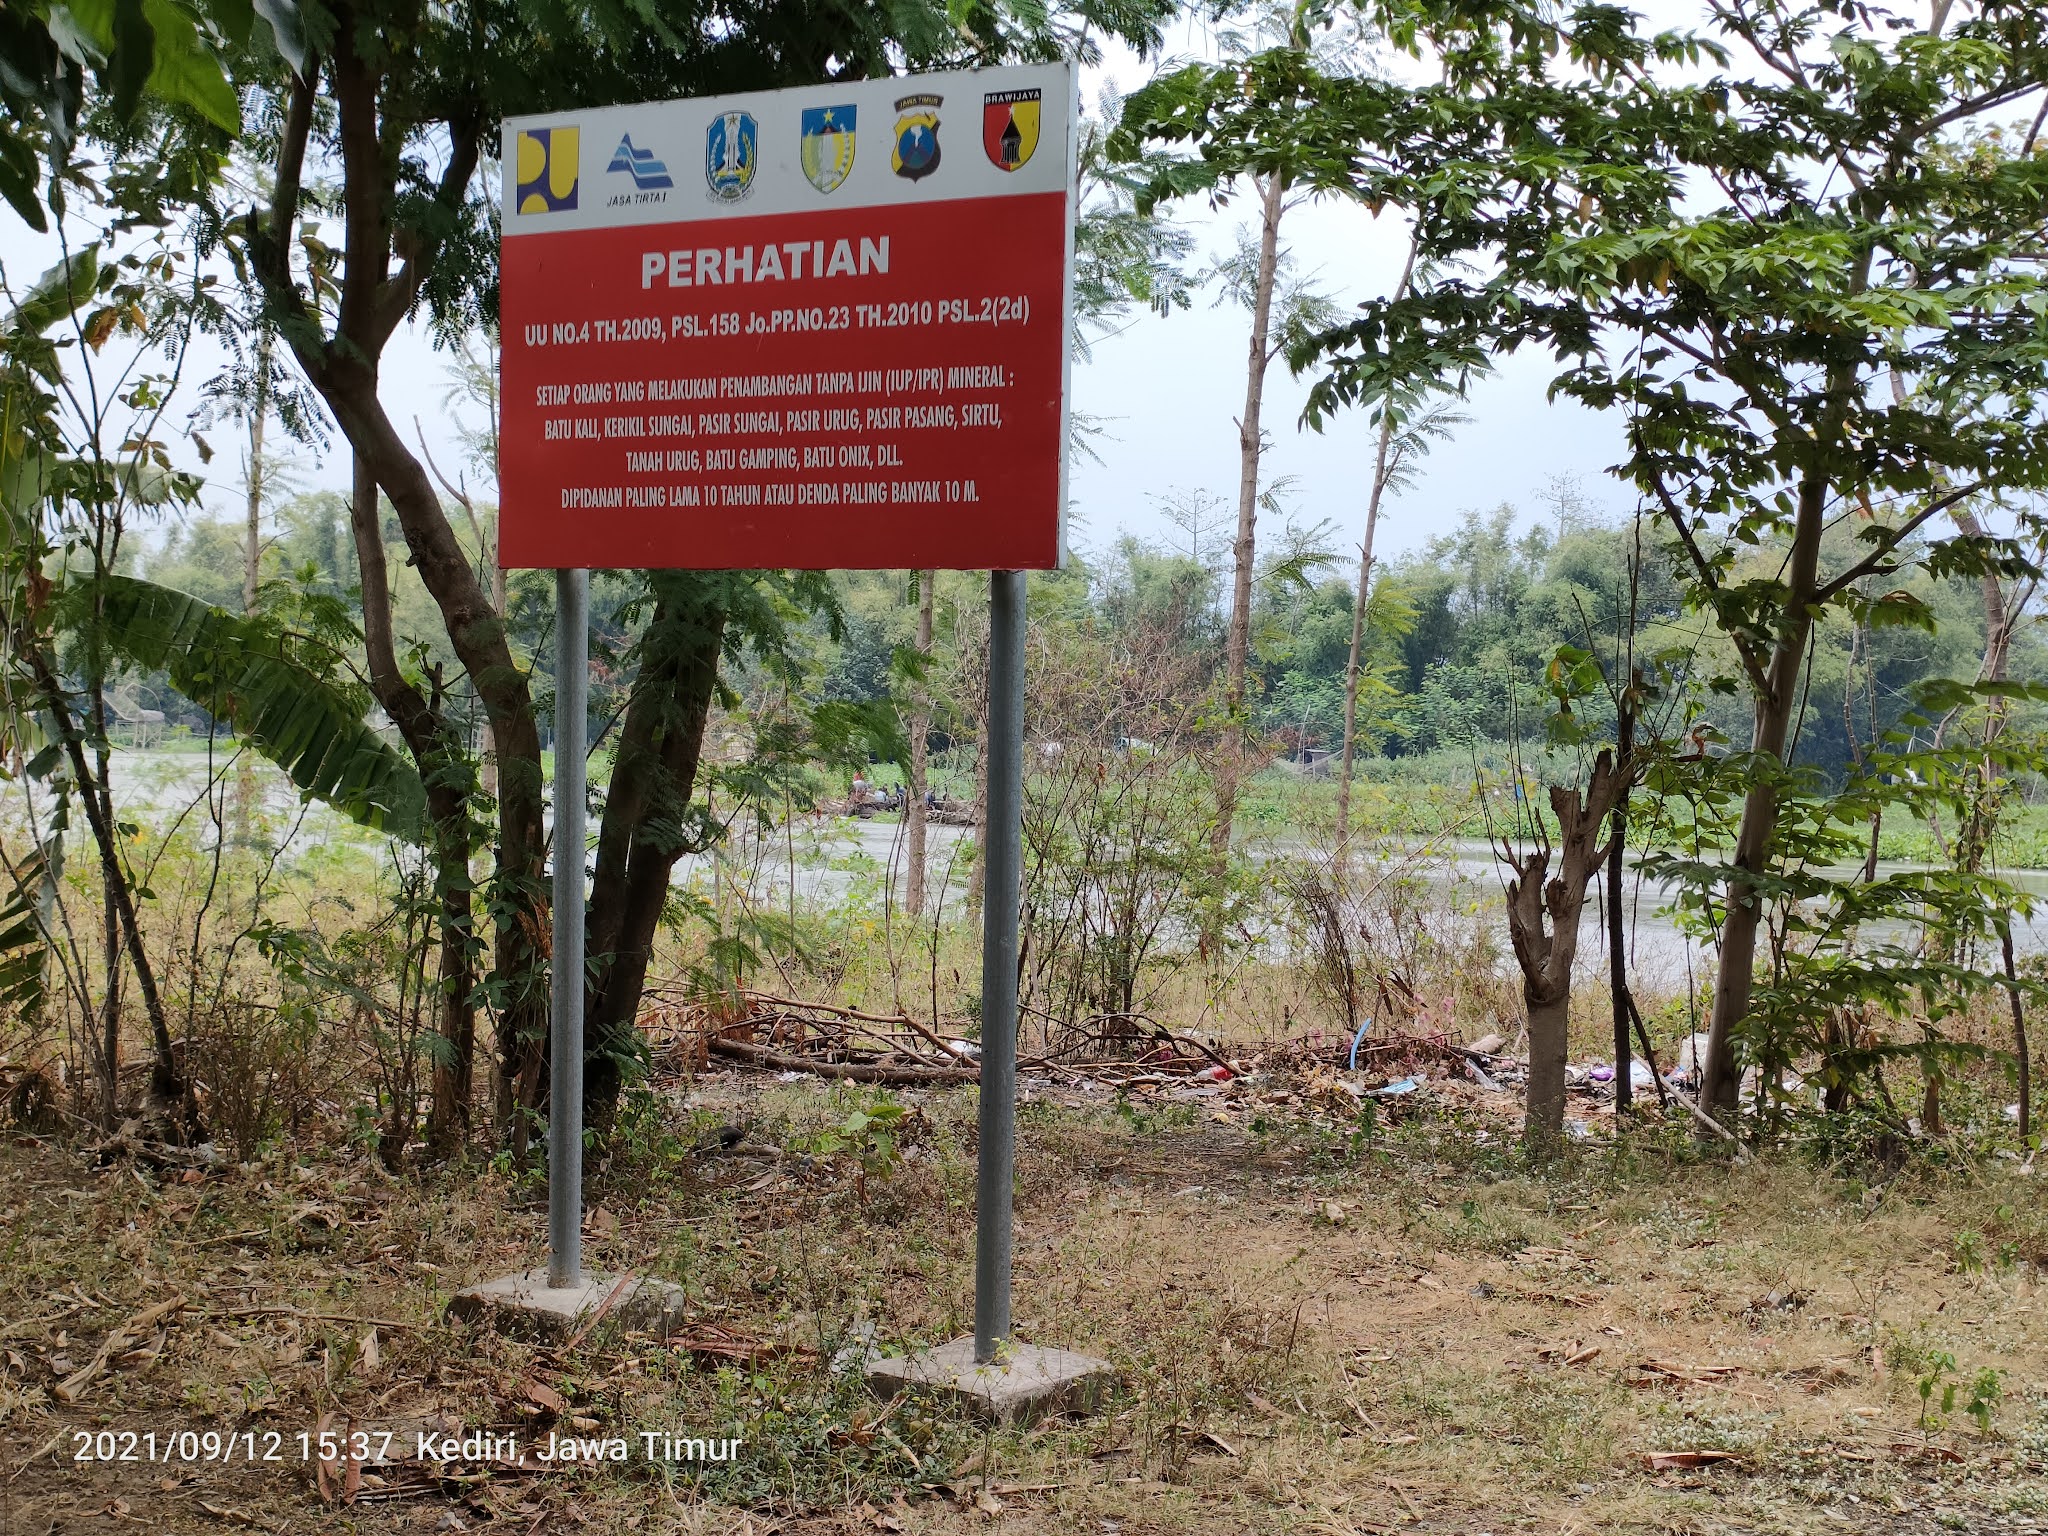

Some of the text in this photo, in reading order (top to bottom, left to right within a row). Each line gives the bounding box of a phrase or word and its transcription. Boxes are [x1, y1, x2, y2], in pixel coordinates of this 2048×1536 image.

[900, 95, 939, 109] JAWA TIMUR
[986, 90, 1040, 104] BRAWIJAYA
[606, 194, 632, 208] JASA
[635, 192, 661, 205] TIRTA
[642, 236, 889, 289] PERHATIAN
[525, 324, 548, 347] UU
[552, 321, 590, 345] NO.4
[593, 317, 667, 344] TH.2009,
[671, 312, 740, 338] PSL.158
[855, 300, 932, 328] TH.2010
[938, 295, 1030, 327] PSL.2(2d)
[536, 384, 571, 406] SETIAP
[573, 382, 612, 405] ORANG
[613, 380, 645, 403] YANG
[647, 377, 717, 401] MELAKUKAN
[720, 373, 812, 398] PENAMBANGAN
[815, 371, 855, 395] TANPA
[858, 370, 882, 393] IJIN
[885, 366, 944, 398] (IUP/IPR)
[947, 364, 1006, 389] MINERAL
[544, 403, 1002, 442] BATU KALI, KERIKIL SUNGAI, PASIR SUNGAI, PASIR URUG, PASIR PASANG, SIRTU,
[625, 444, 904, 474] TANAH URUG, BATU GAMPING, BATU ONIX, DLL.
[561, 480, 980, 509] DIPIDANAN PALING LAMA 10 TAHUN ATAU DENDA PALING BANYAK 10 M.
